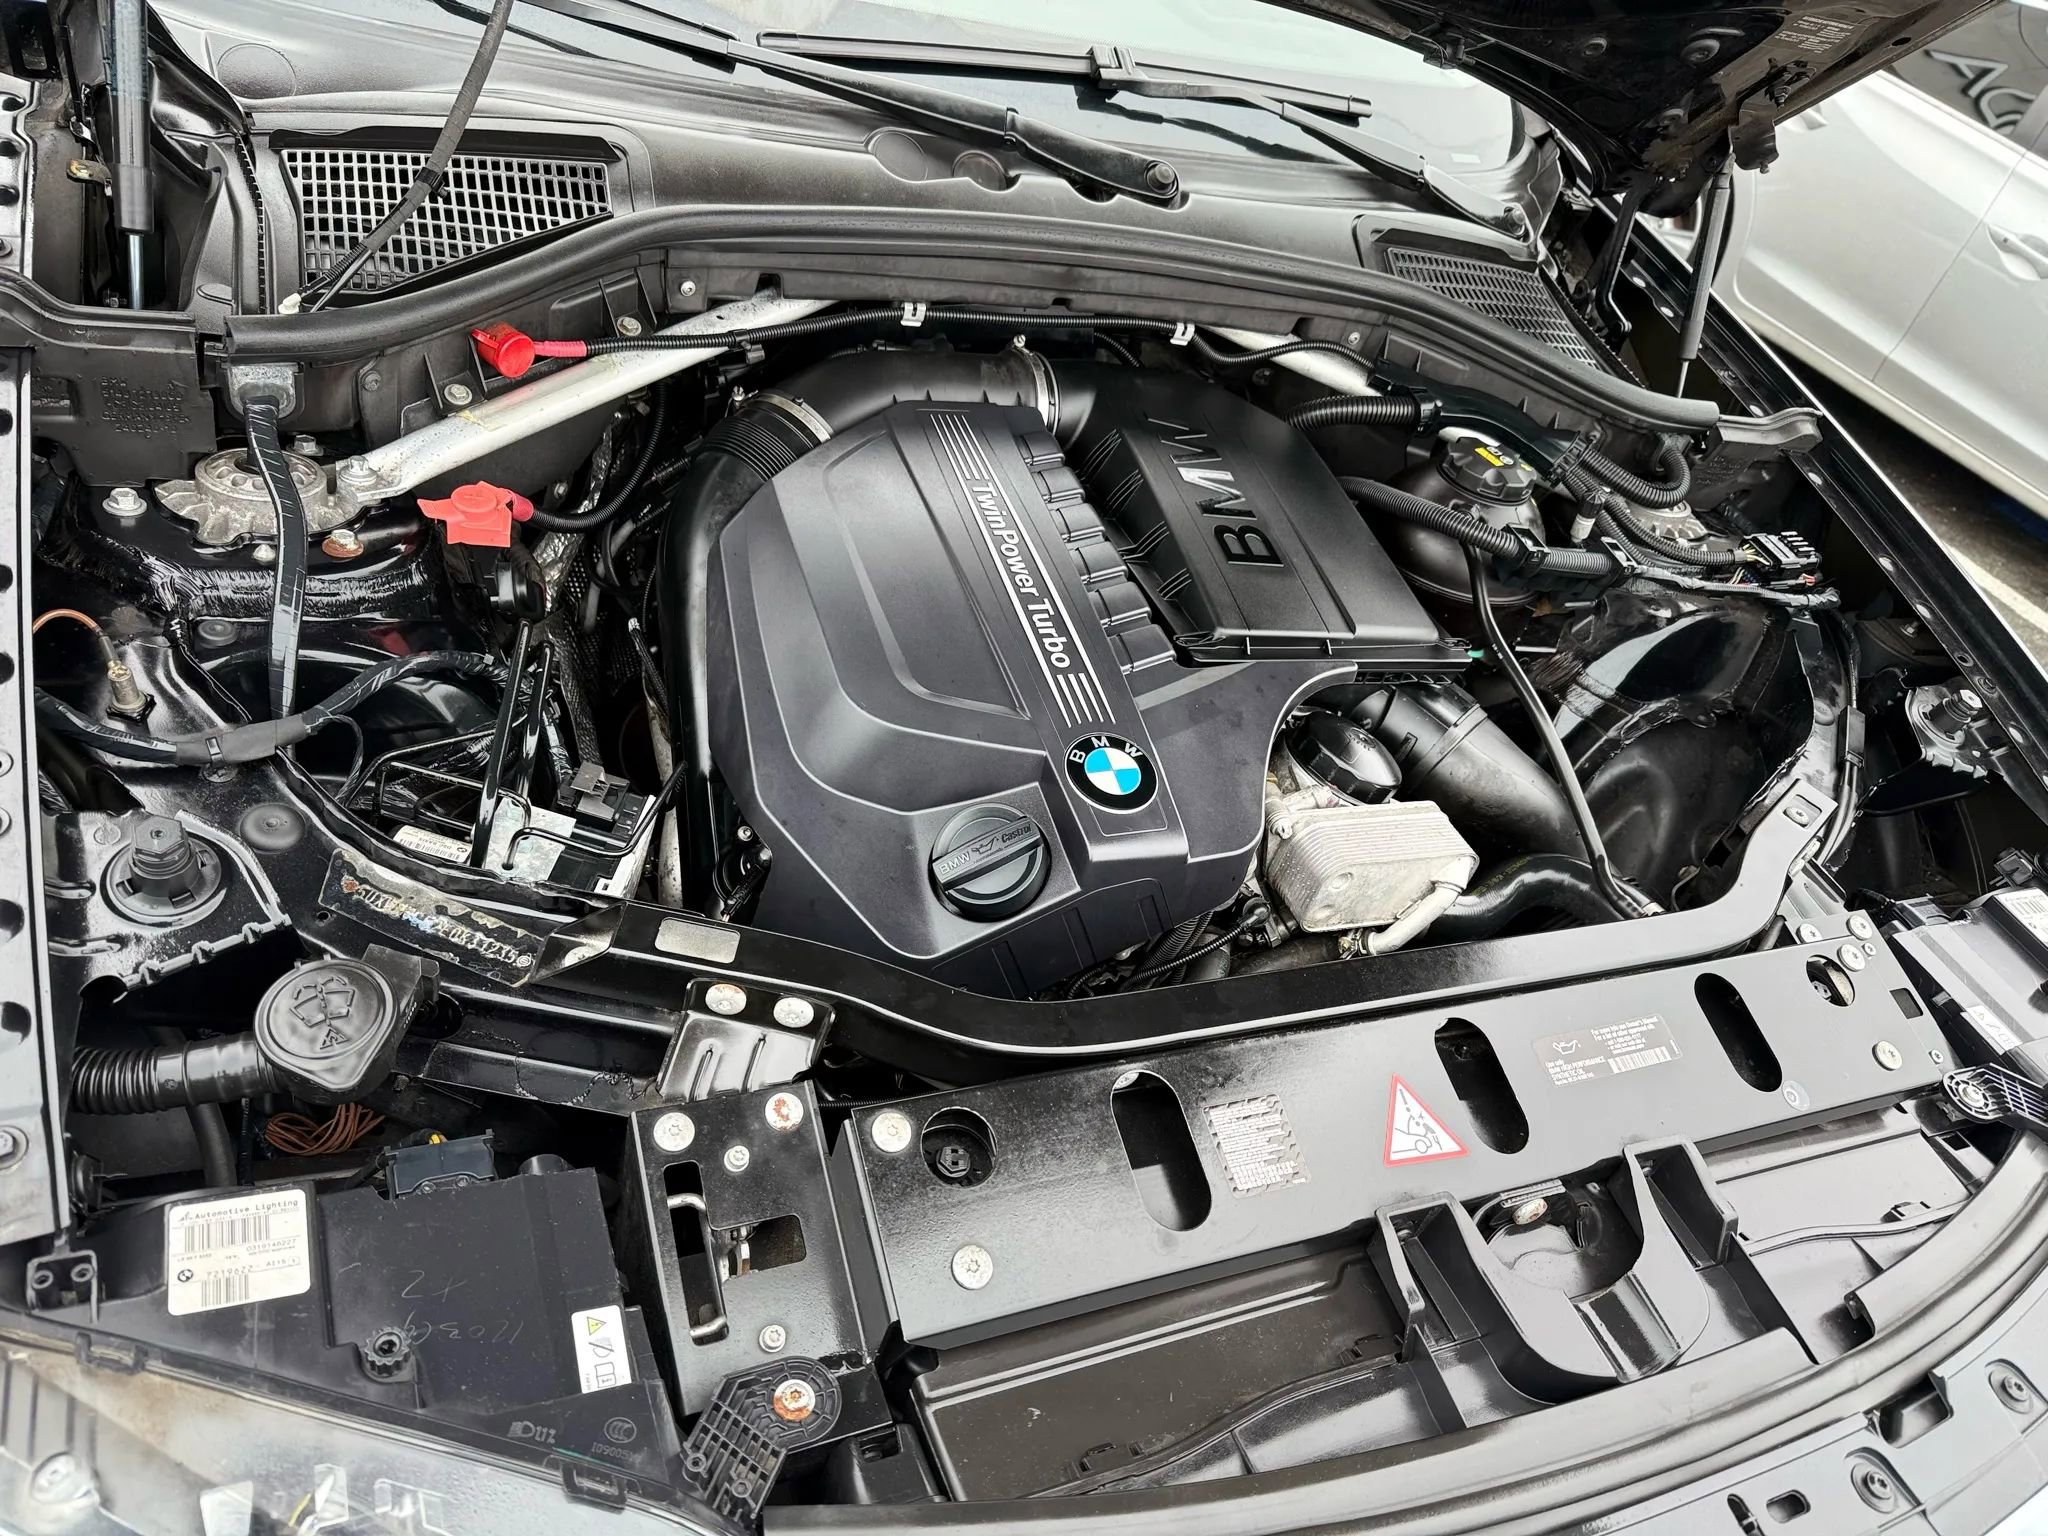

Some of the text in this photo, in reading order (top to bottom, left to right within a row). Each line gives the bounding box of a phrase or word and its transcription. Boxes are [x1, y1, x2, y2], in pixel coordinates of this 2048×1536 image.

[1147, 418, 1285, 567] BMW
[972, 482, 1071, 669] TwinPower Turbo
[1069, 736, 1143, 763] BMW
[940, 851, 971, 875] BMW
[1001, 824, 1032, 843] Castrol
[195, 1206, 250, 1220] Automotive
[255, 1200, 299, 1212] Lighting
